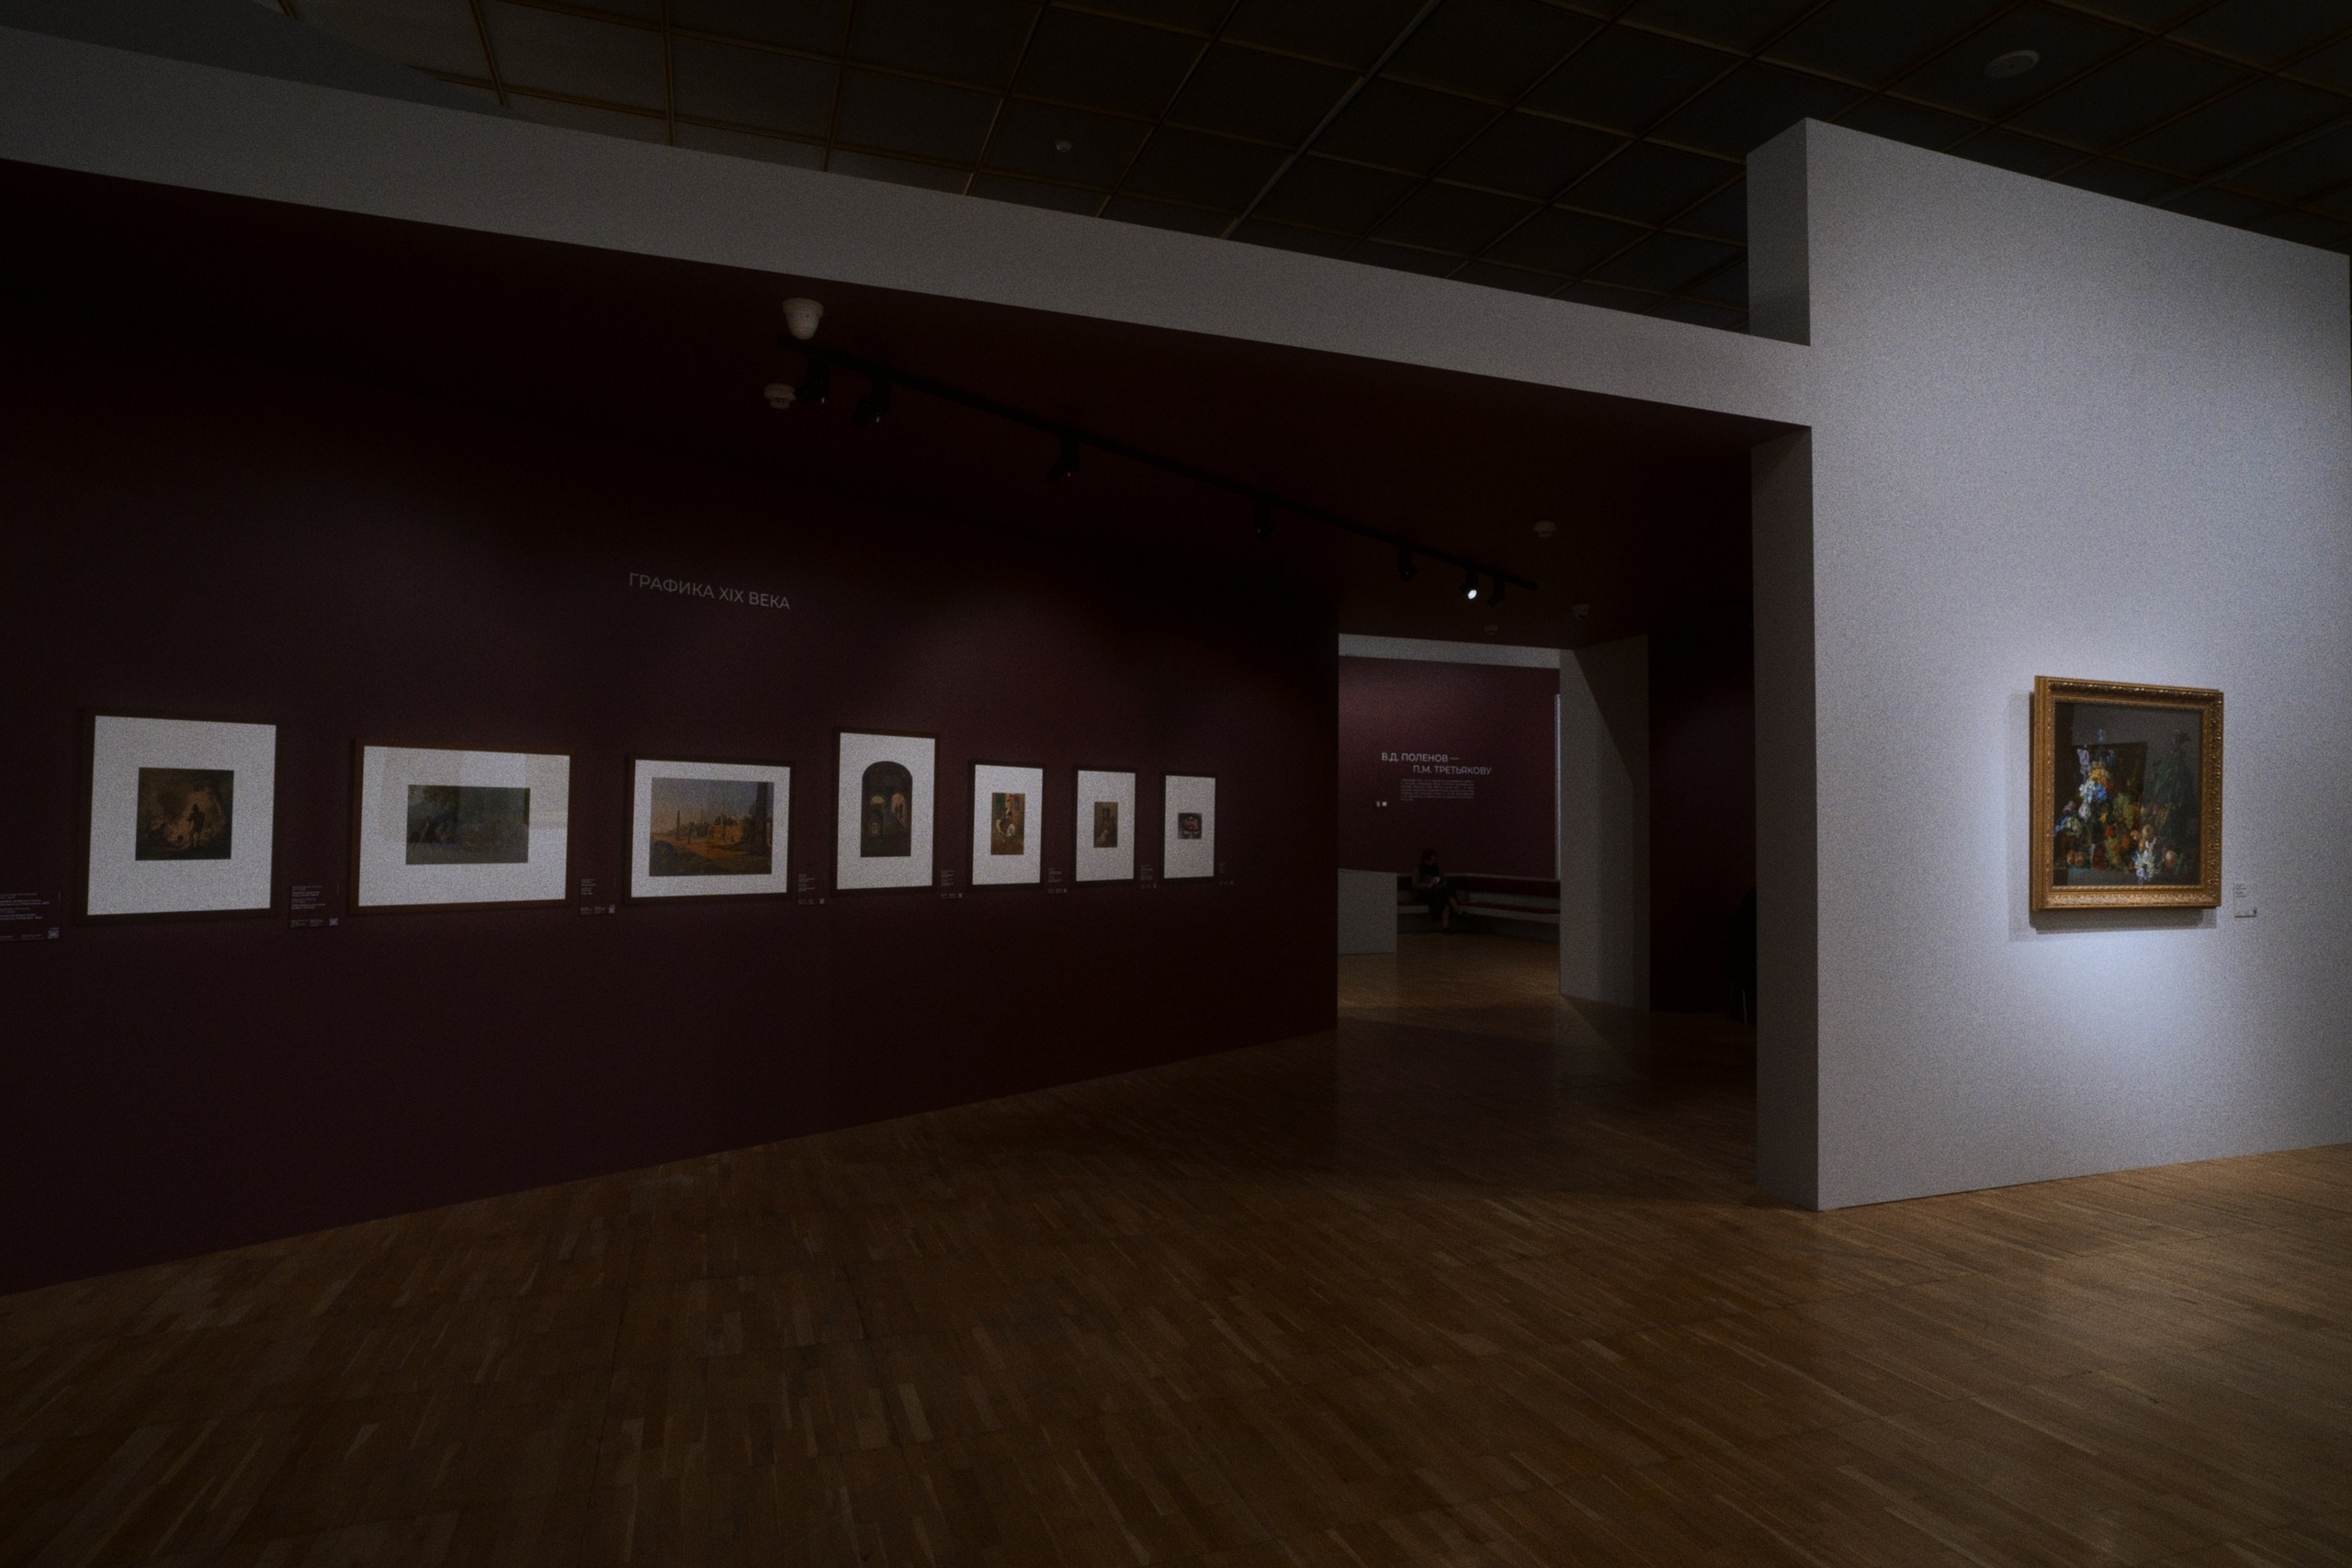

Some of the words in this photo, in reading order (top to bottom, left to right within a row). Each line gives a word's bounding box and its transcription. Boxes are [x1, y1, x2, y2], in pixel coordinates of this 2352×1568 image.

[629, 572, 715, 599] ГРАФИКА
[718, 587, 744, 604] XIX
[749, 592, 790, 610] ВЕКА
[1381, 752, 1399, 762] В.Д.
[1401, 752, 1448, 762] ПОЛЕНОВ
[1413, 764, 1432, 773] П.М.
[1433, 765, 1492, 775] ТРЕТЬЯКОВУ
